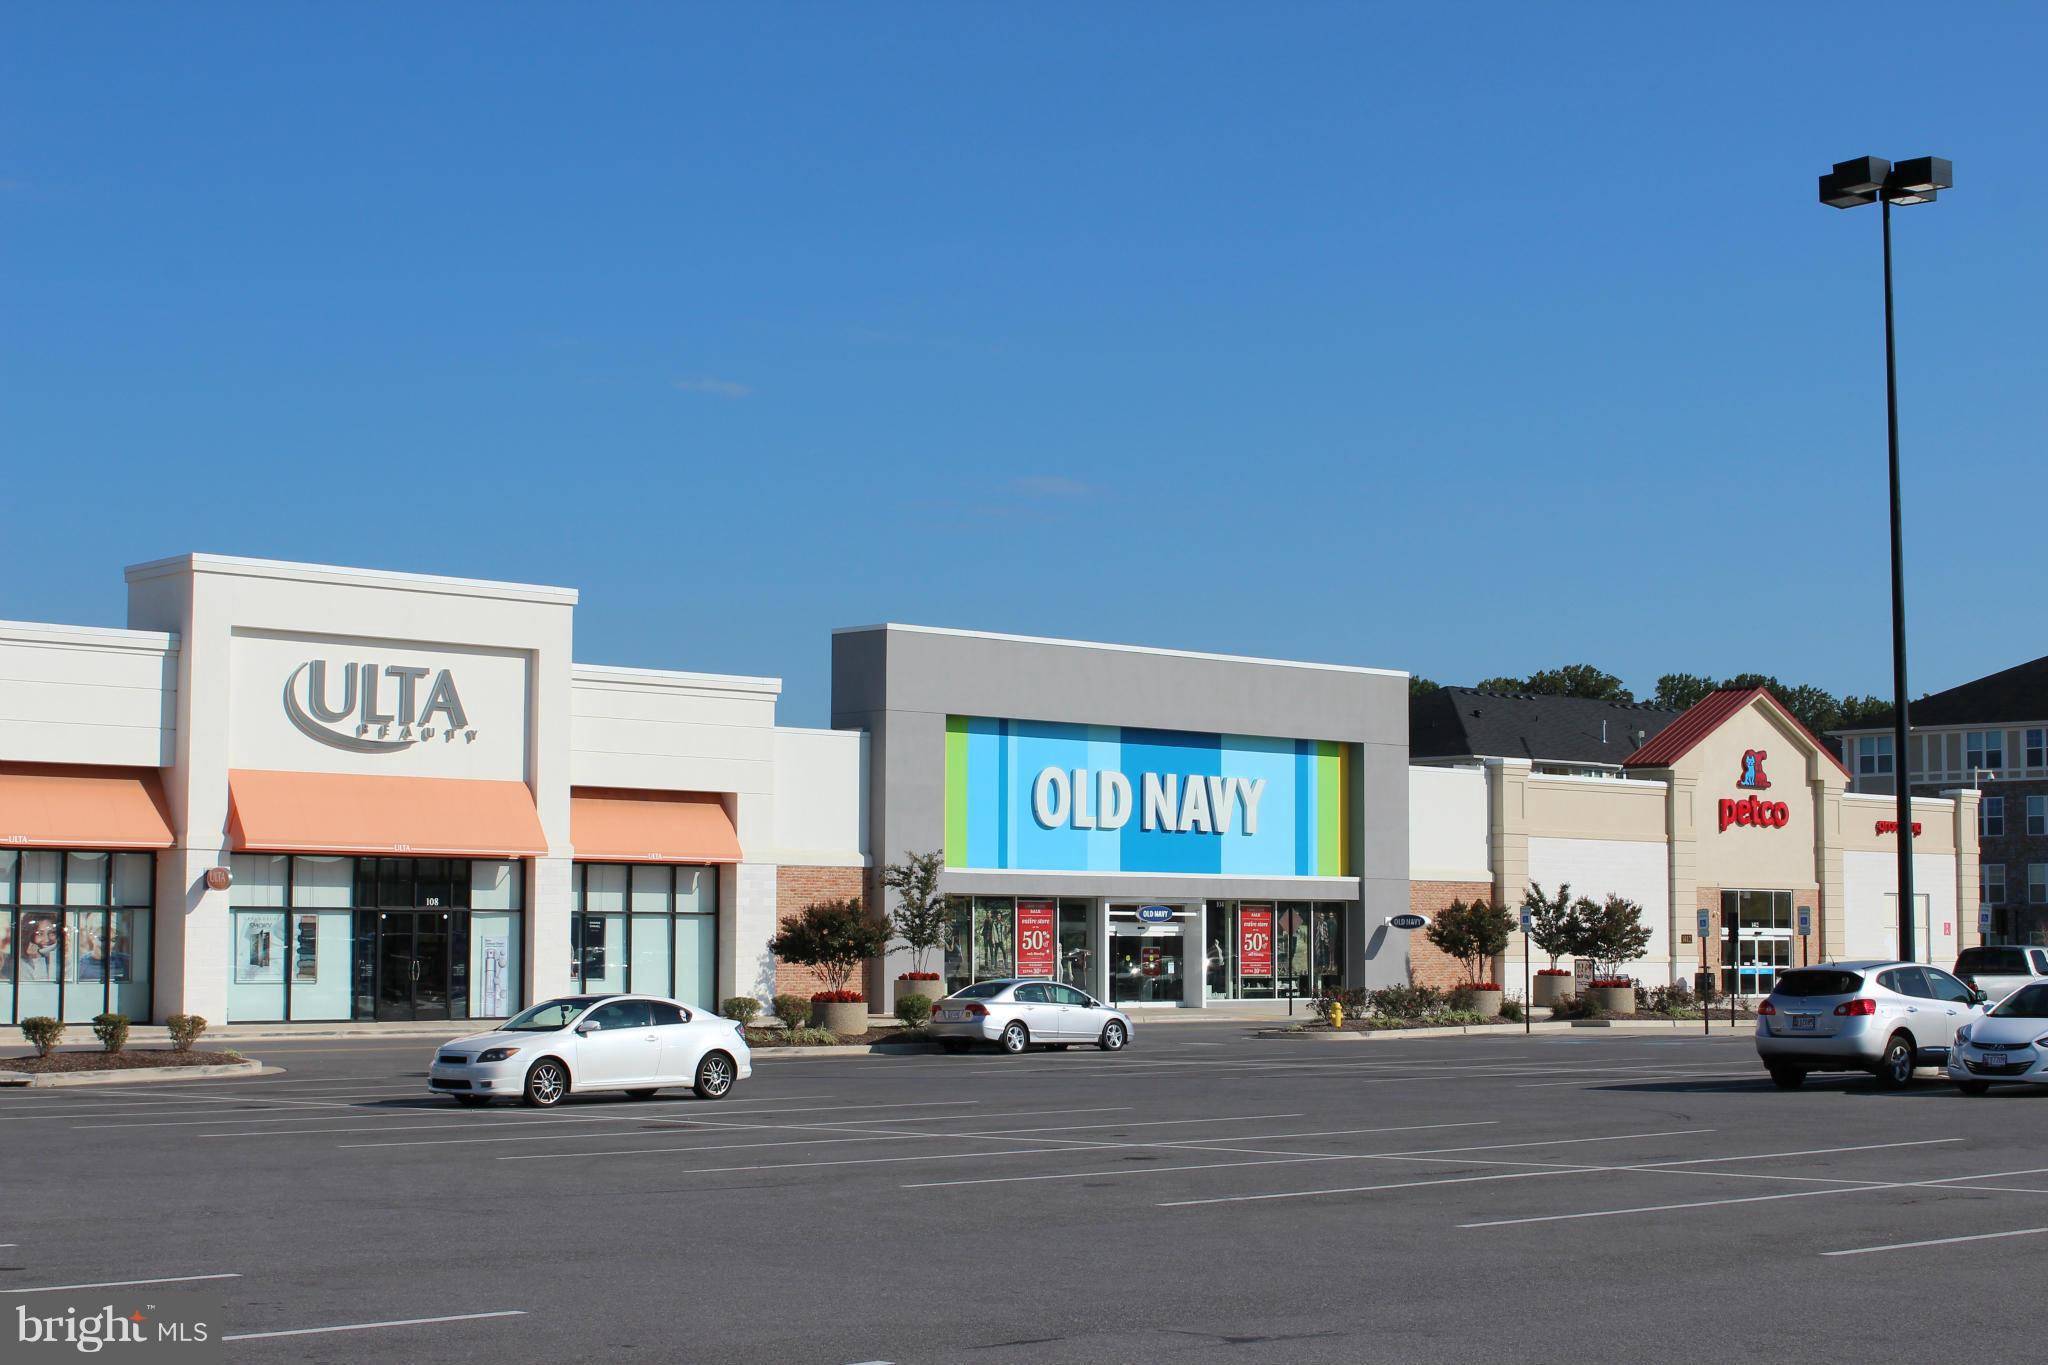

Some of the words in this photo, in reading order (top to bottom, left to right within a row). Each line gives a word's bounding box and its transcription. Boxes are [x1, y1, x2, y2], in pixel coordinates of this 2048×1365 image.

[309, 659, 469, 729] ULTA
[356, 722, 478, 745] BEAUTY
[1031, 766, 1133, 831] OLD
[1140, 772, 1267, 837] NAVY
[1718, 794, 1789, 834] petco
[8, 835, 28, 843] ULTA
[394, 844, 411, 852] ULTA
[209, 871, 226, 882] ULTA
[425, 897, 439, 906] 108
[1143, 910, 1154, 918] OLD
[1154, 910, 1168, 918] NAVY
[1393, 918, 1405, 926] OLD
[1406, 918, 1421, 926] NAVY
